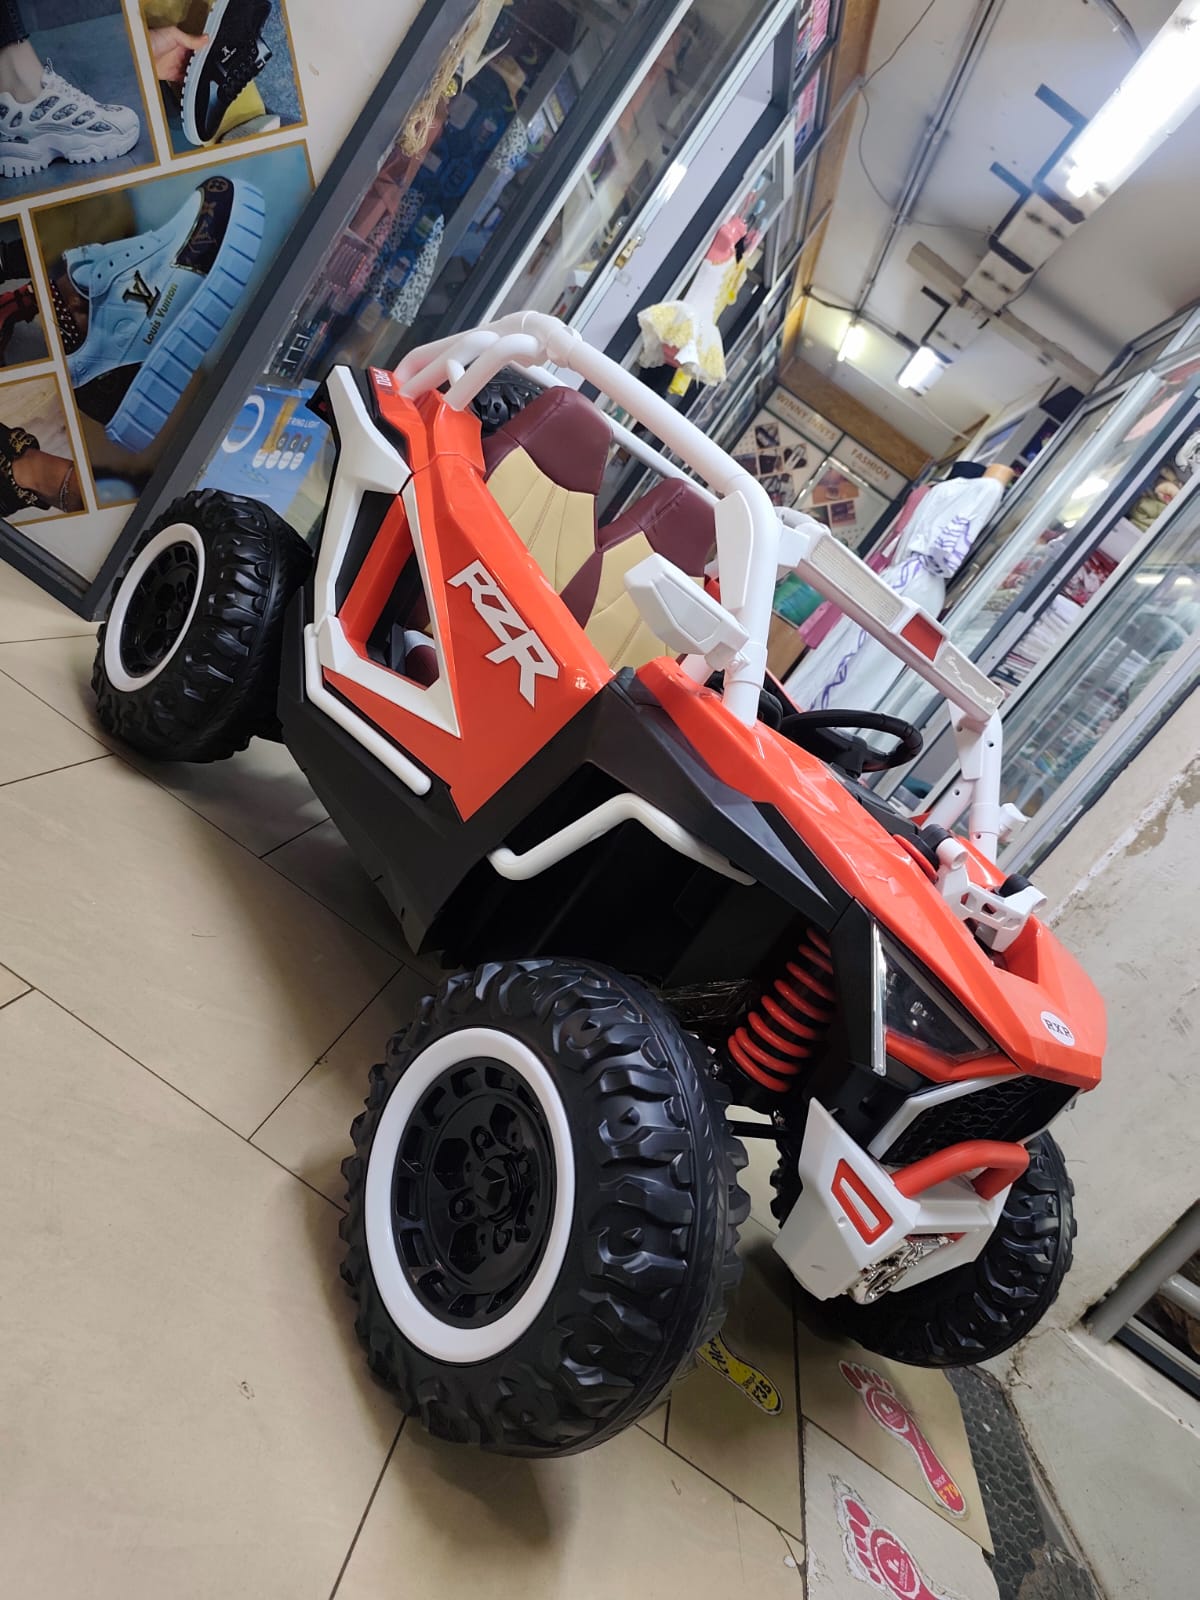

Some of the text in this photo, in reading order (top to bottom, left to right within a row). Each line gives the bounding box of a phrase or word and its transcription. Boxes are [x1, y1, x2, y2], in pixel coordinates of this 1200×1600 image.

[143, 320, 161, 345] Louis
[851, 448, 890, 480] FASHION
[447, 559, 560, 708] RZR
